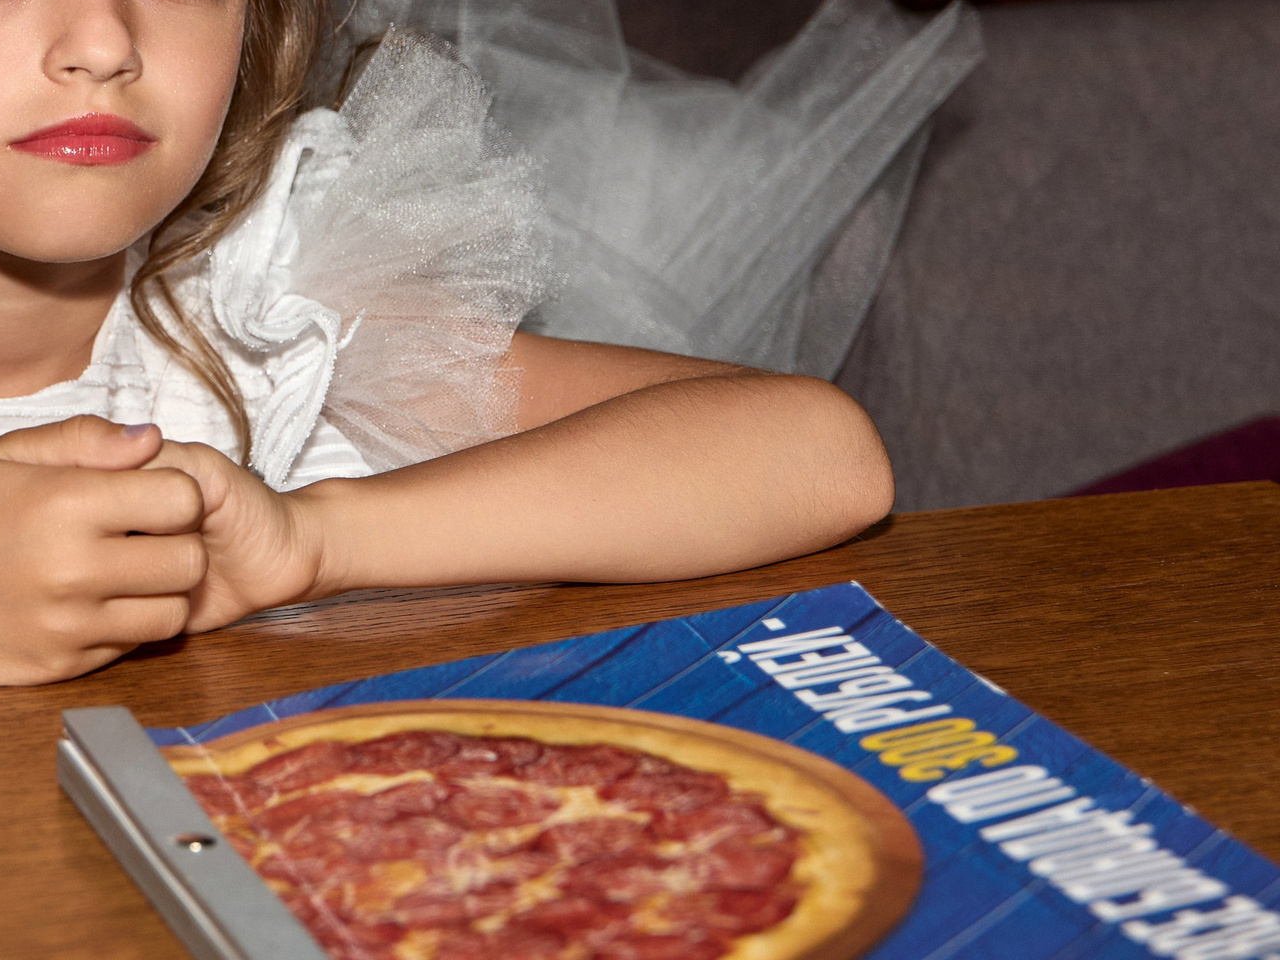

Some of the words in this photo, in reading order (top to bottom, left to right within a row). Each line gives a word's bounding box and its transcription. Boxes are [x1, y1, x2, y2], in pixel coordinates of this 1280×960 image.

[717, 625, 953, 734] РУБЛЕЙ
[859, 717, 1018, 782] 300
[926, 764, 1077, 824] ПО
[978, 795, 1230, 924] БЛЮДА
